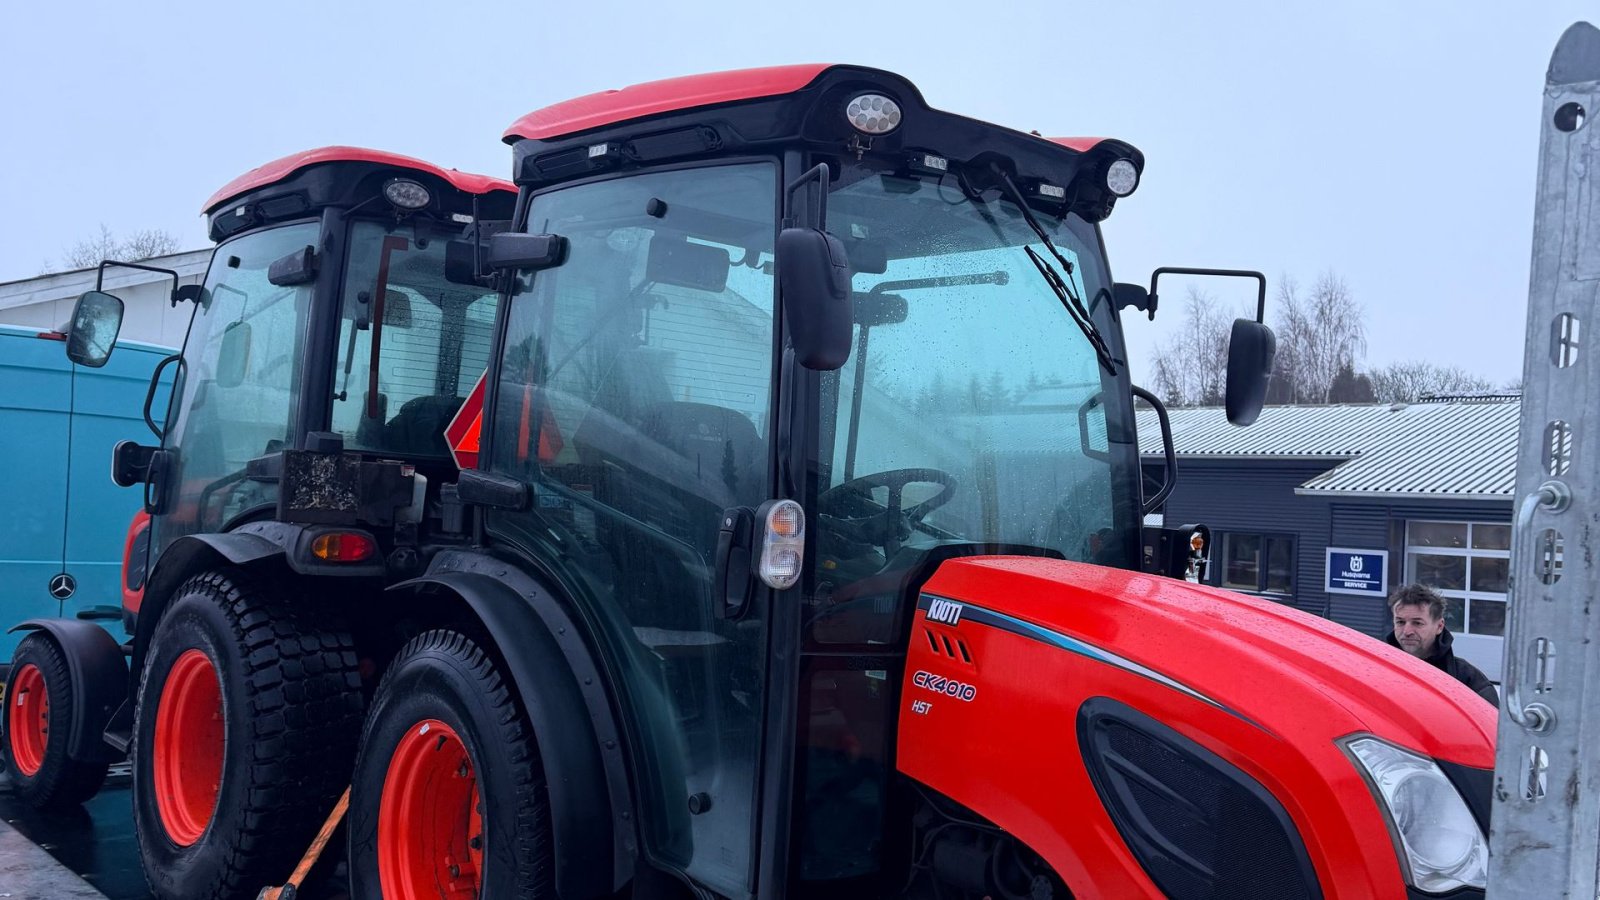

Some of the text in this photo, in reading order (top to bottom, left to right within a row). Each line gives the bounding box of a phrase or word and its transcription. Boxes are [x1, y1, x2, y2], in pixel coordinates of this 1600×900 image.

[1341, 571, 1371, 579] Husqvarna
[927, 599, 962, 624] KIOTI
[913, 670, 977, 702] CK4010
[912, 700, 932, 714] HST
